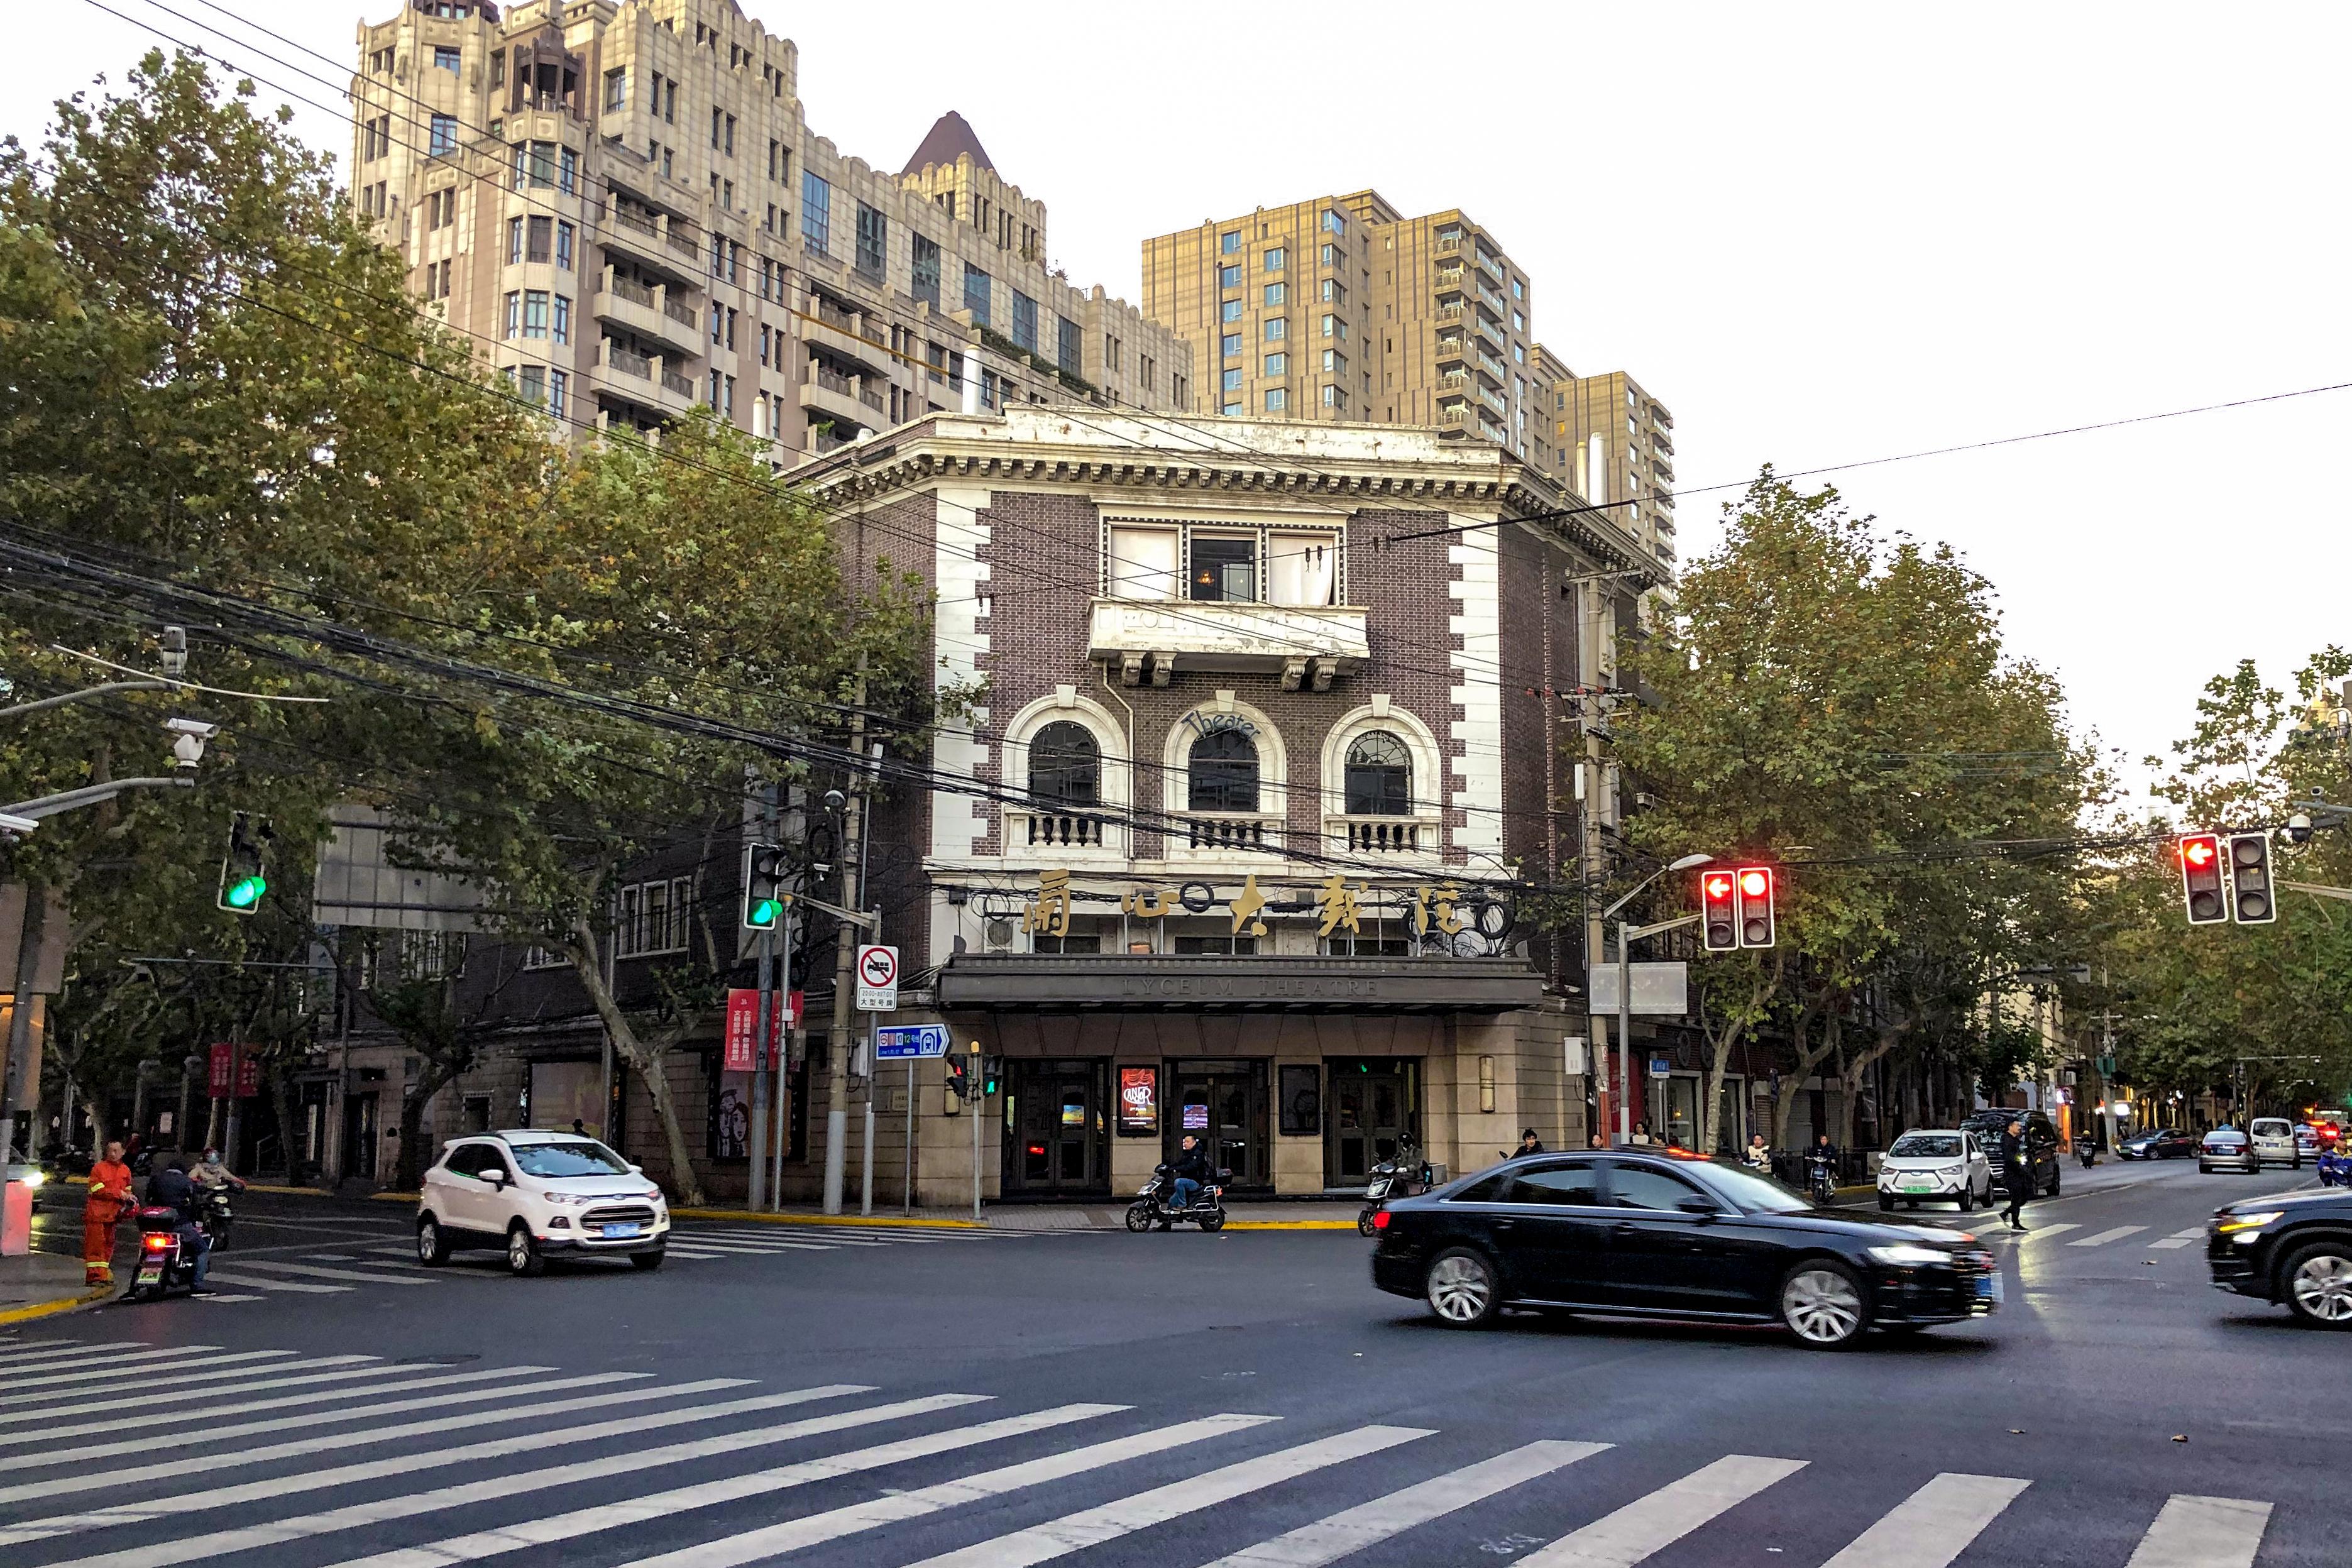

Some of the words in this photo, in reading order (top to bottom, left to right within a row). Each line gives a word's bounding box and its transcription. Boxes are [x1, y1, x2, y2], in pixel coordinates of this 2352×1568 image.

[1181, 710, 1261, 740] Theater
[1122, 979, 1233, 995] LYCEUM
[1258, 980, 1378, 997] THEATRE
[860, 998, 893, 1007] 大型号牌
[897, 1035, 903, 1043] 10
[904, 1034, 911, 1043] 12
